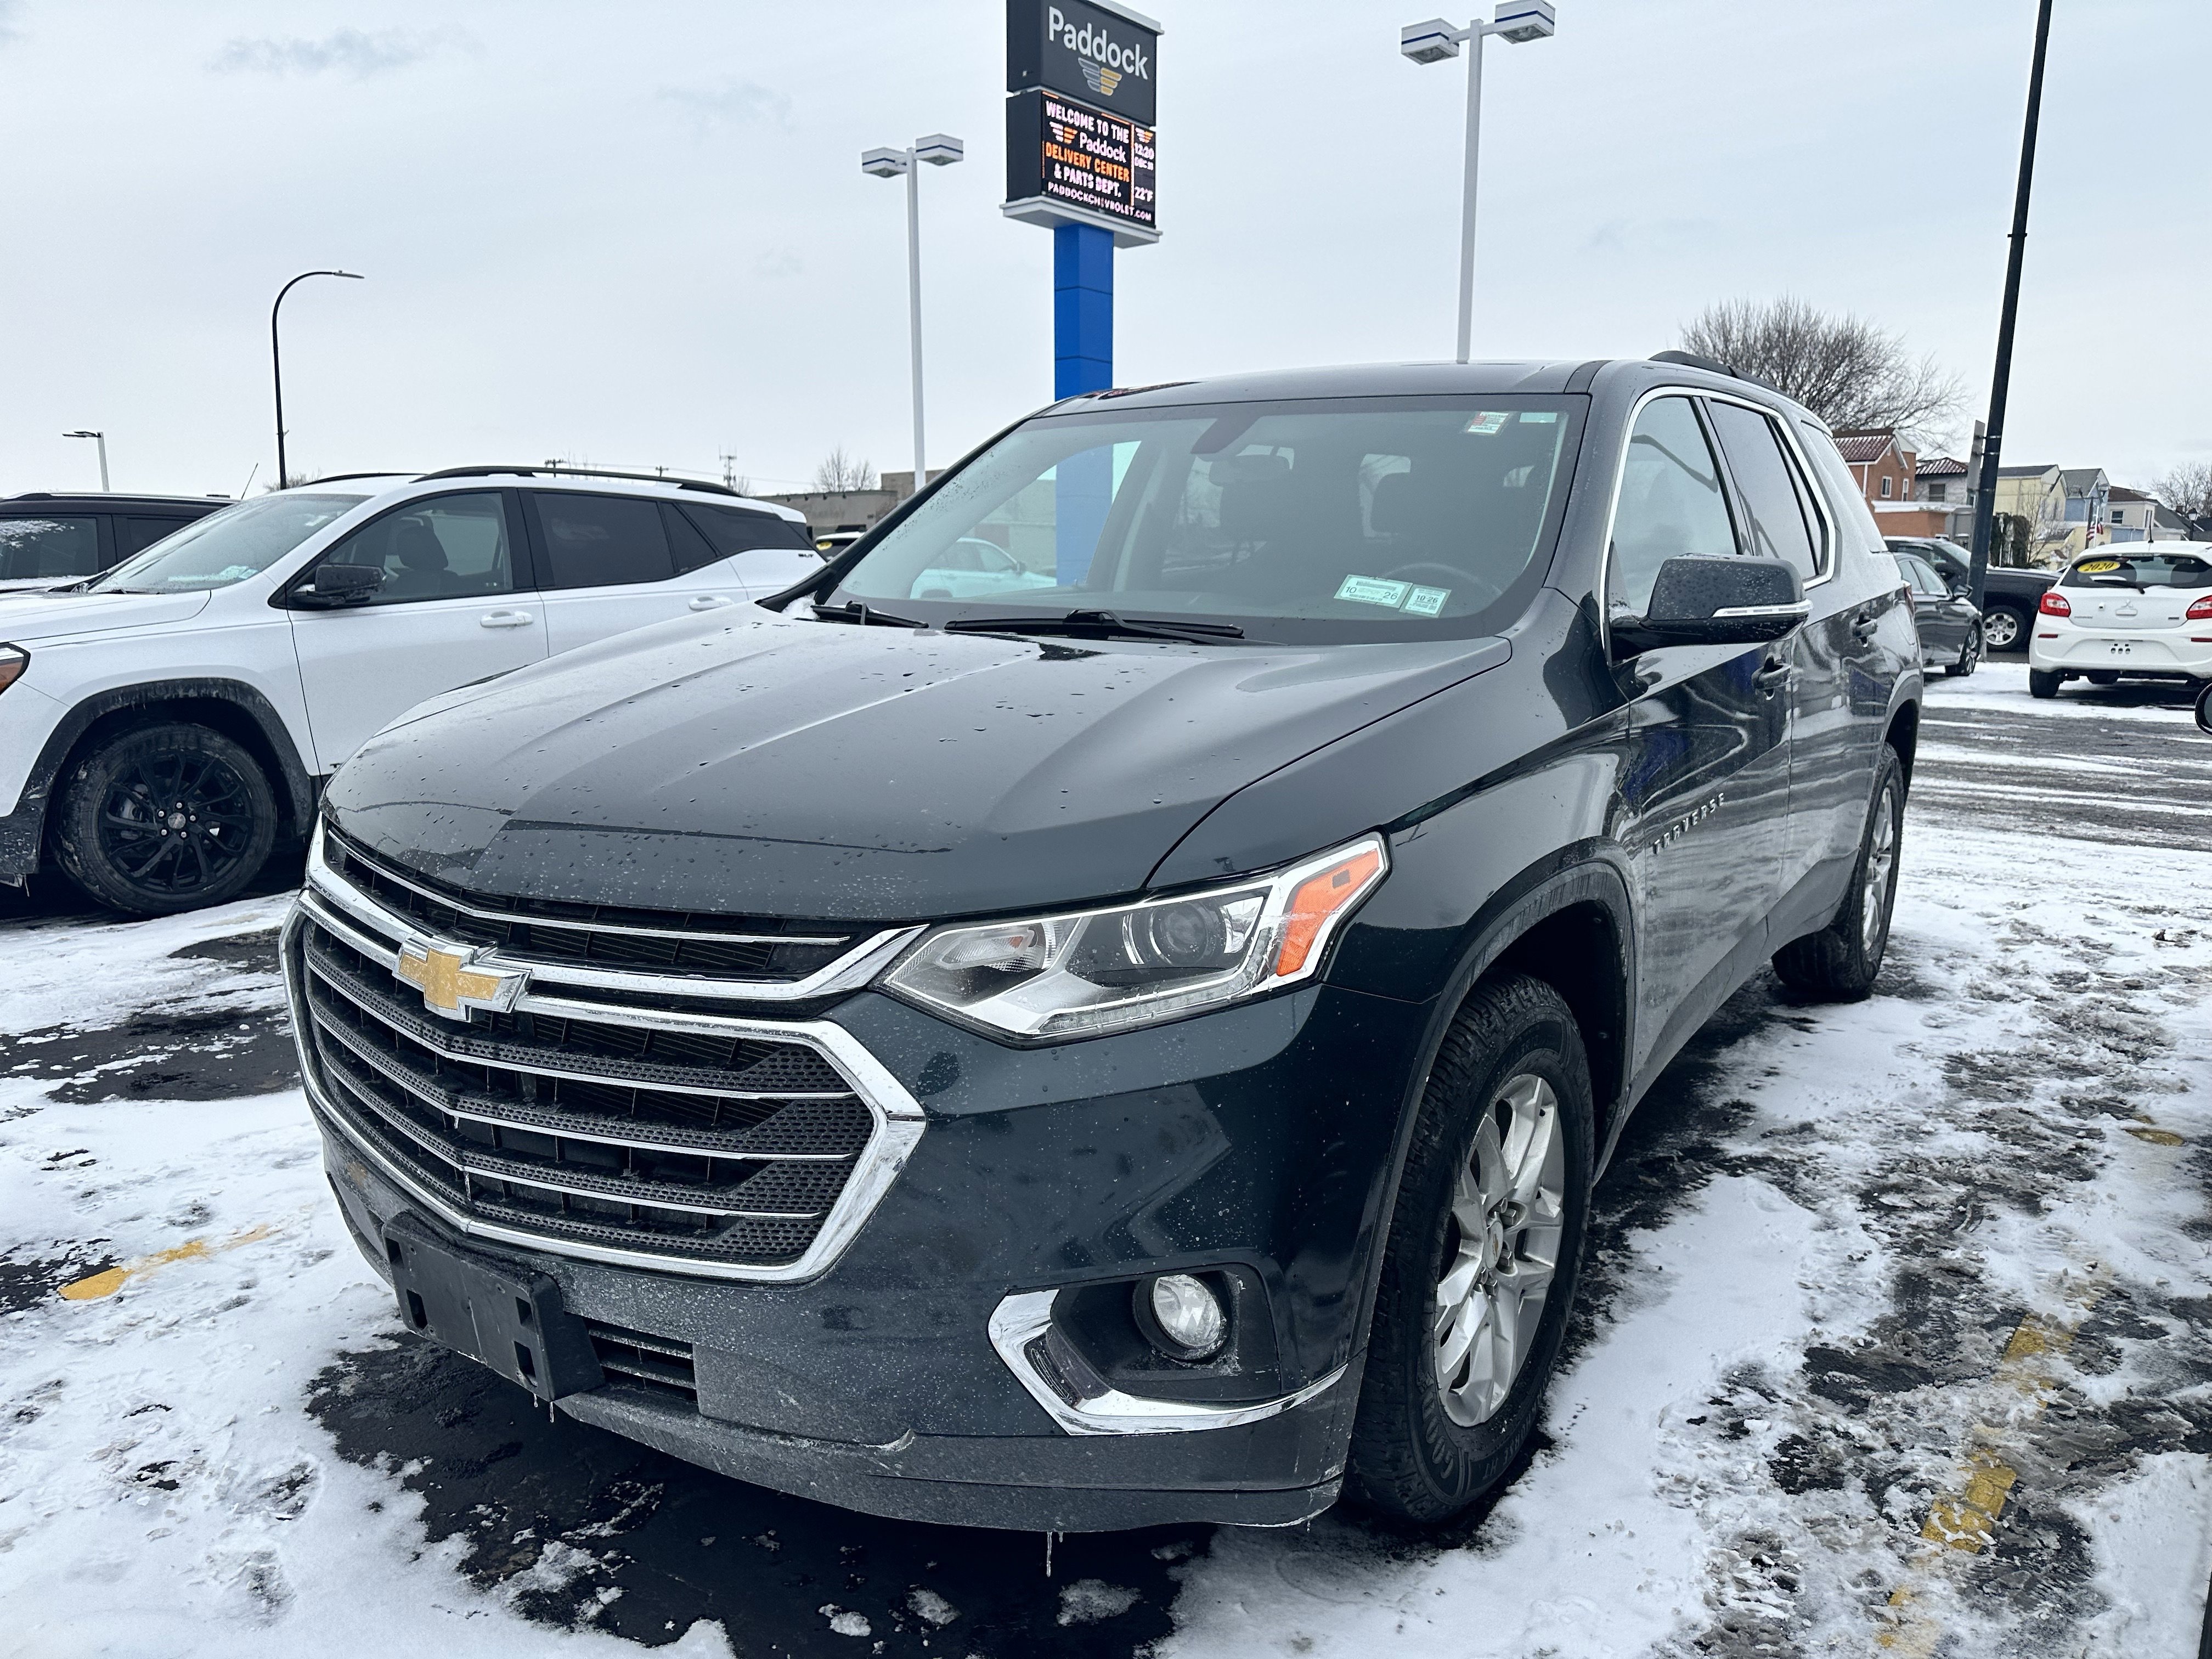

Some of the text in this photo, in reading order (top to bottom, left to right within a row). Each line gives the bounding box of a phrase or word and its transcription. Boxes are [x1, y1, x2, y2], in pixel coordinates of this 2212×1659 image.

[1049, 6, 1148, 80] Paddock
[1046, 100, 1129, 143] WELCOME TO THE
[1046, 142, 1130, 182] DELIVERY CENTER
[1080, 132, 1126, 163] Paddock
[1054, 162, 1121, 198] & PARTS DEPT.
[2084, 562, 2114, 572] 2020
[1383, 591, 1398, 600] 26
[1652, 793, 1724, 854] TRAVERSE
